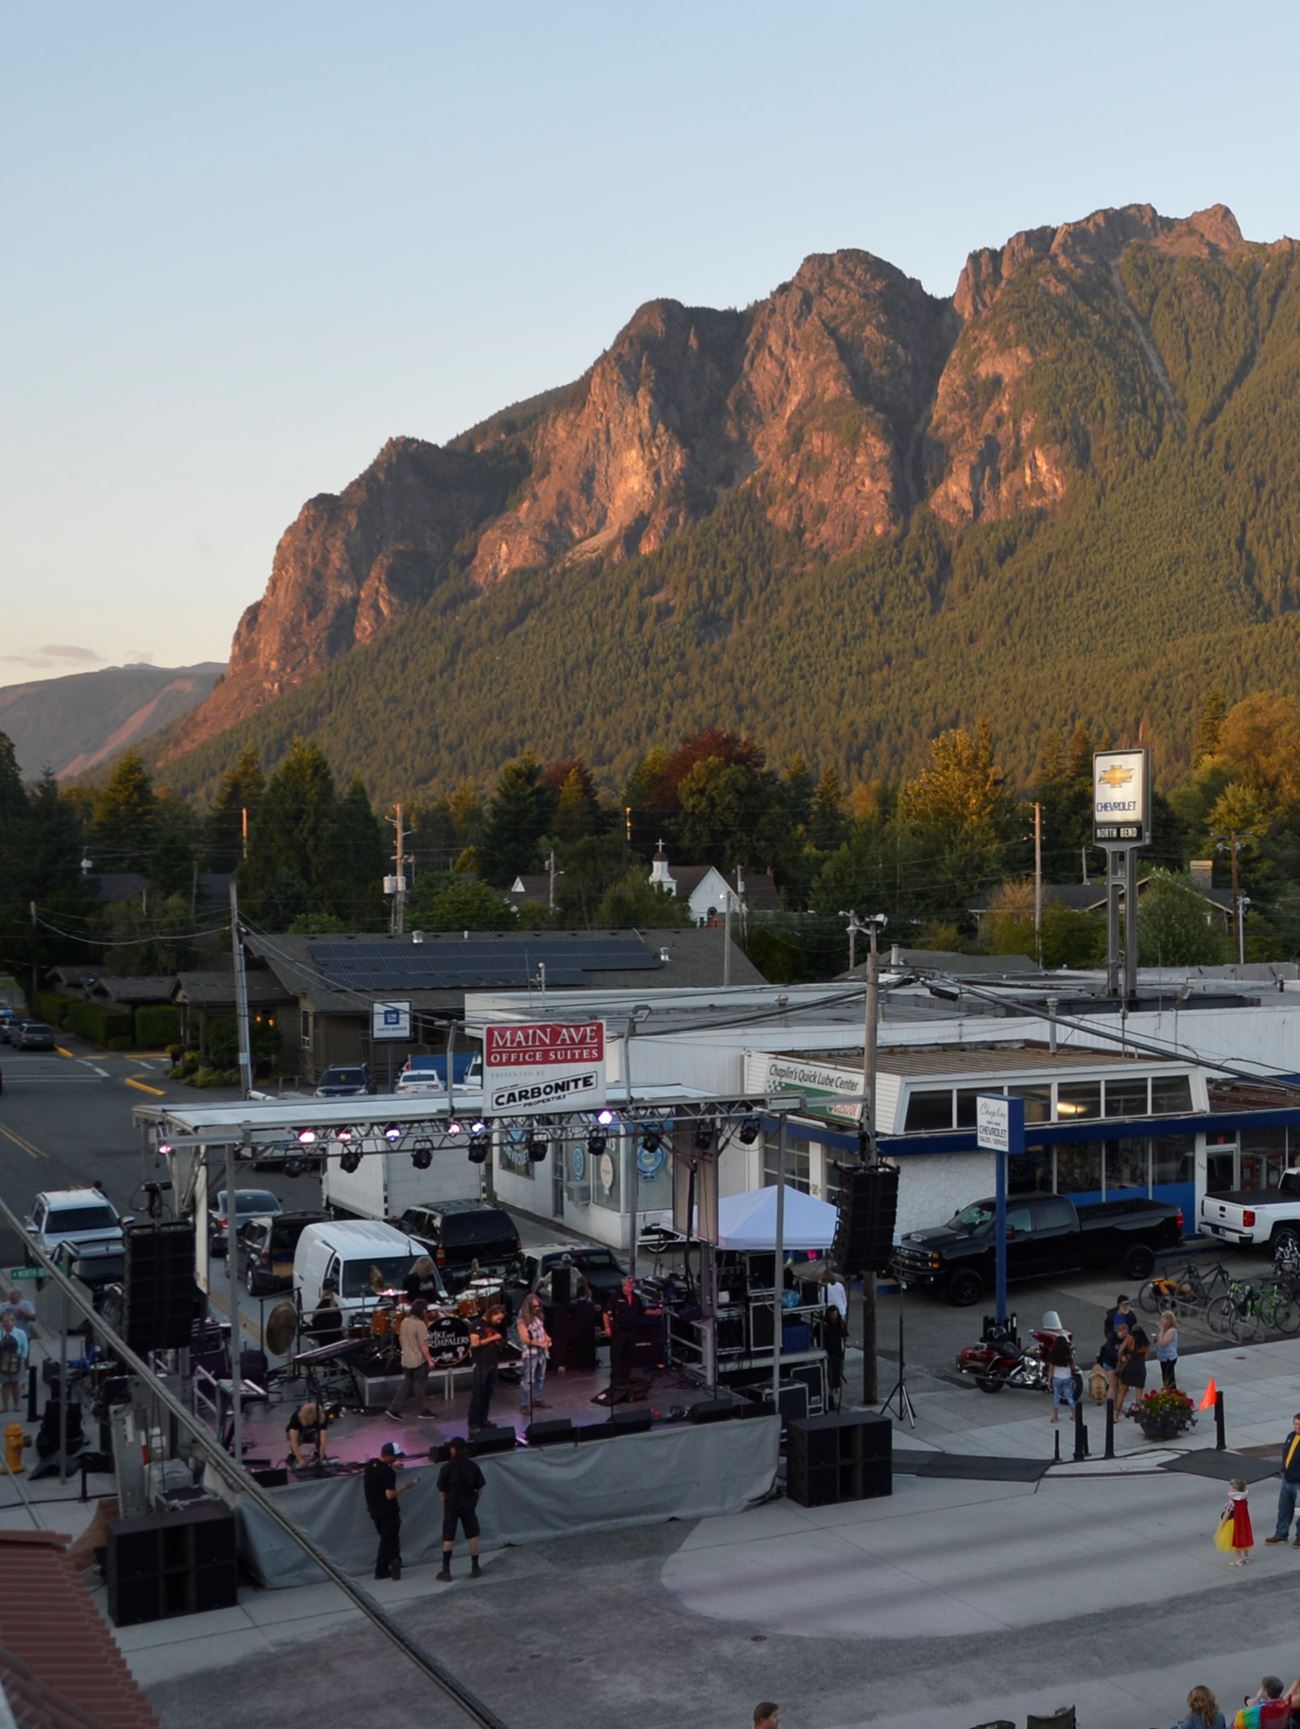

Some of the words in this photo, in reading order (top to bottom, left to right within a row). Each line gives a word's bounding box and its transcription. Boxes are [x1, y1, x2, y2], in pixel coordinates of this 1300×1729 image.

[1096, 800, 1137, 812] CHEVROLET
[1096, 827, 1118, 839] NORTH
[1120, 826, 1138, 838] BEND
[491, 1028, 552, 1048] MAIN
[556, 1026, 599, 1045] AVE
[490, 1051, 543, 1064] OFFICE
[547, 1048, 599, 1061] SUITES
[768, 1063, 799, 1081] Chaplin's
[799, 1069, 818, 1085] Quick
[817, 1072, 835, 1089] Lube
[834, 1076, 860, 1092] Center
[494, 1074, 595, 1107] CARBONITE
[522, 1094, 567, 1109] PROPERTIES
